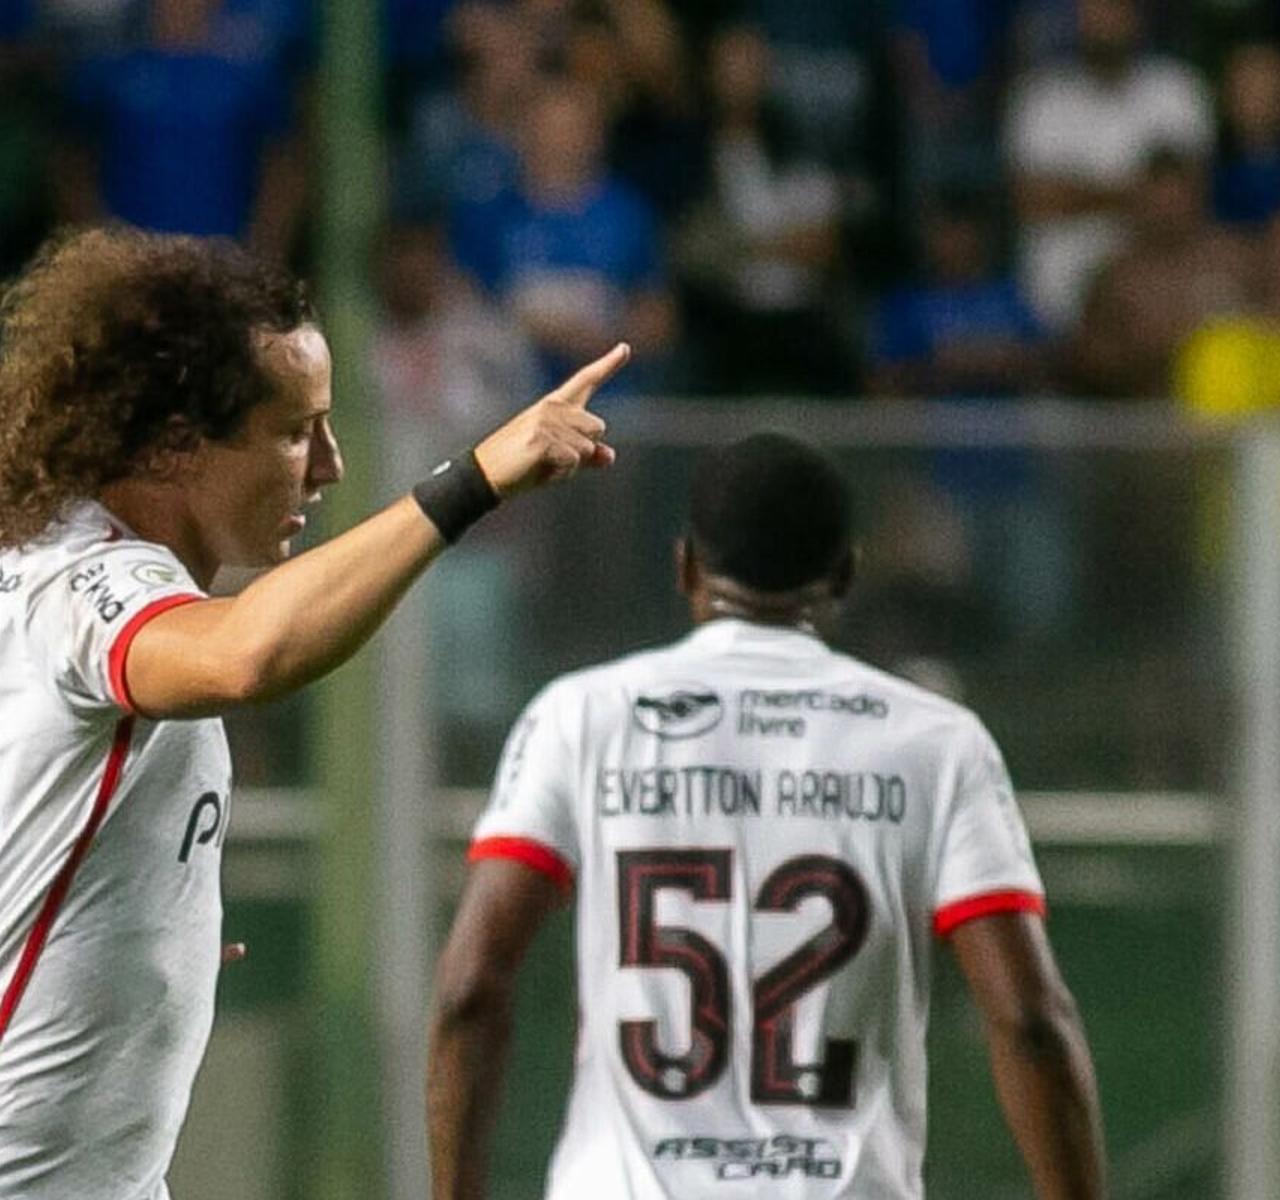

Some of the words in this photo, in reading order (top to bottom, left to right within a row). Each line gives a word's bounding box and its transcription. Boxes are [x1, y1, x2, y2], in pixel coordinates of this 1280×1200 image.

[739, 688, 890, 719] mercado
[737, 712, 807, 738] livre
[598, 765, 763, 818] EVERTTON
[777, 769, 907, 824] ARAUJO
[616, 846, 870, 1110] 52
[654, 1134, 828, 1161] ASSIST
[718, 1157, 842, 1180] CARD
